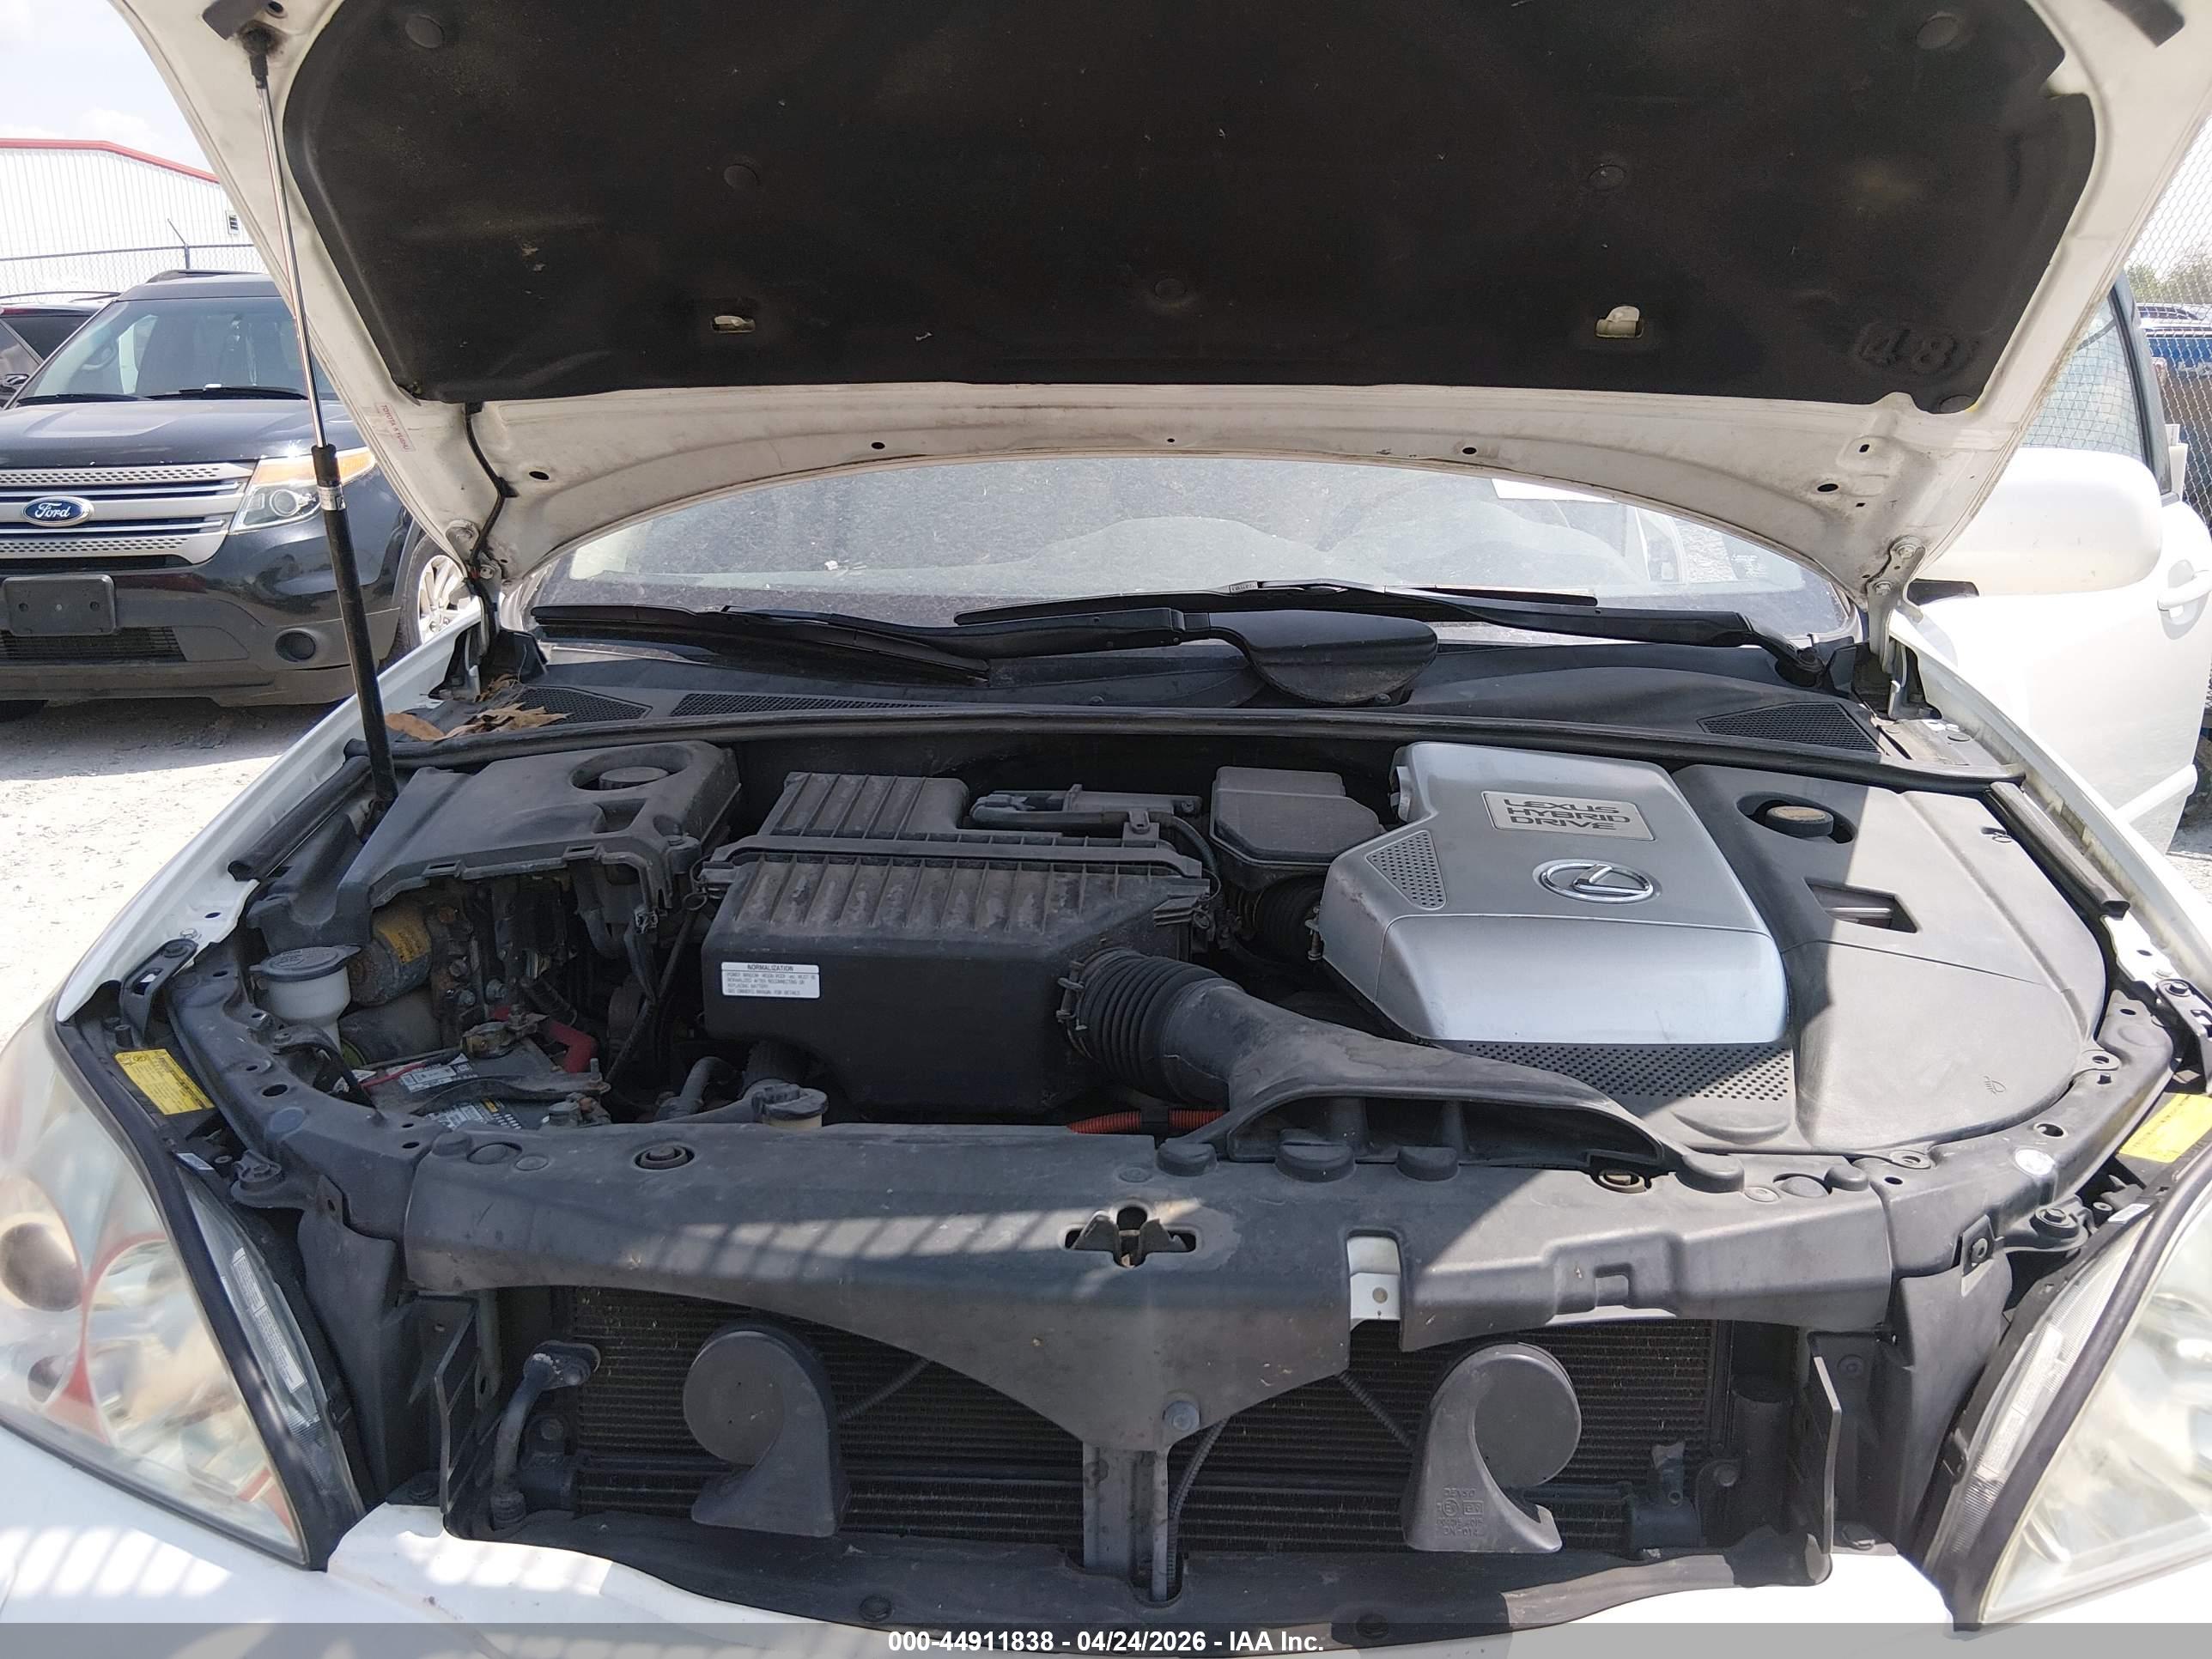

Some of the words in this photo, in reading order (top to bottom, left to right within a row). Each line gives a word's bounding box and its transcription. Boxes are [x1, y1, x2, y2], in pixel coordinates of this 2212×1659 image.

[381, 404, 396, 426] TOYOTA
[34, 502, 72, 518] Ford
[1504, 799, 1620, 814] LEXUS
[1507, 807, 1631, 823] HYBRID
[1510, 816, 1616, 830] DRIVE
